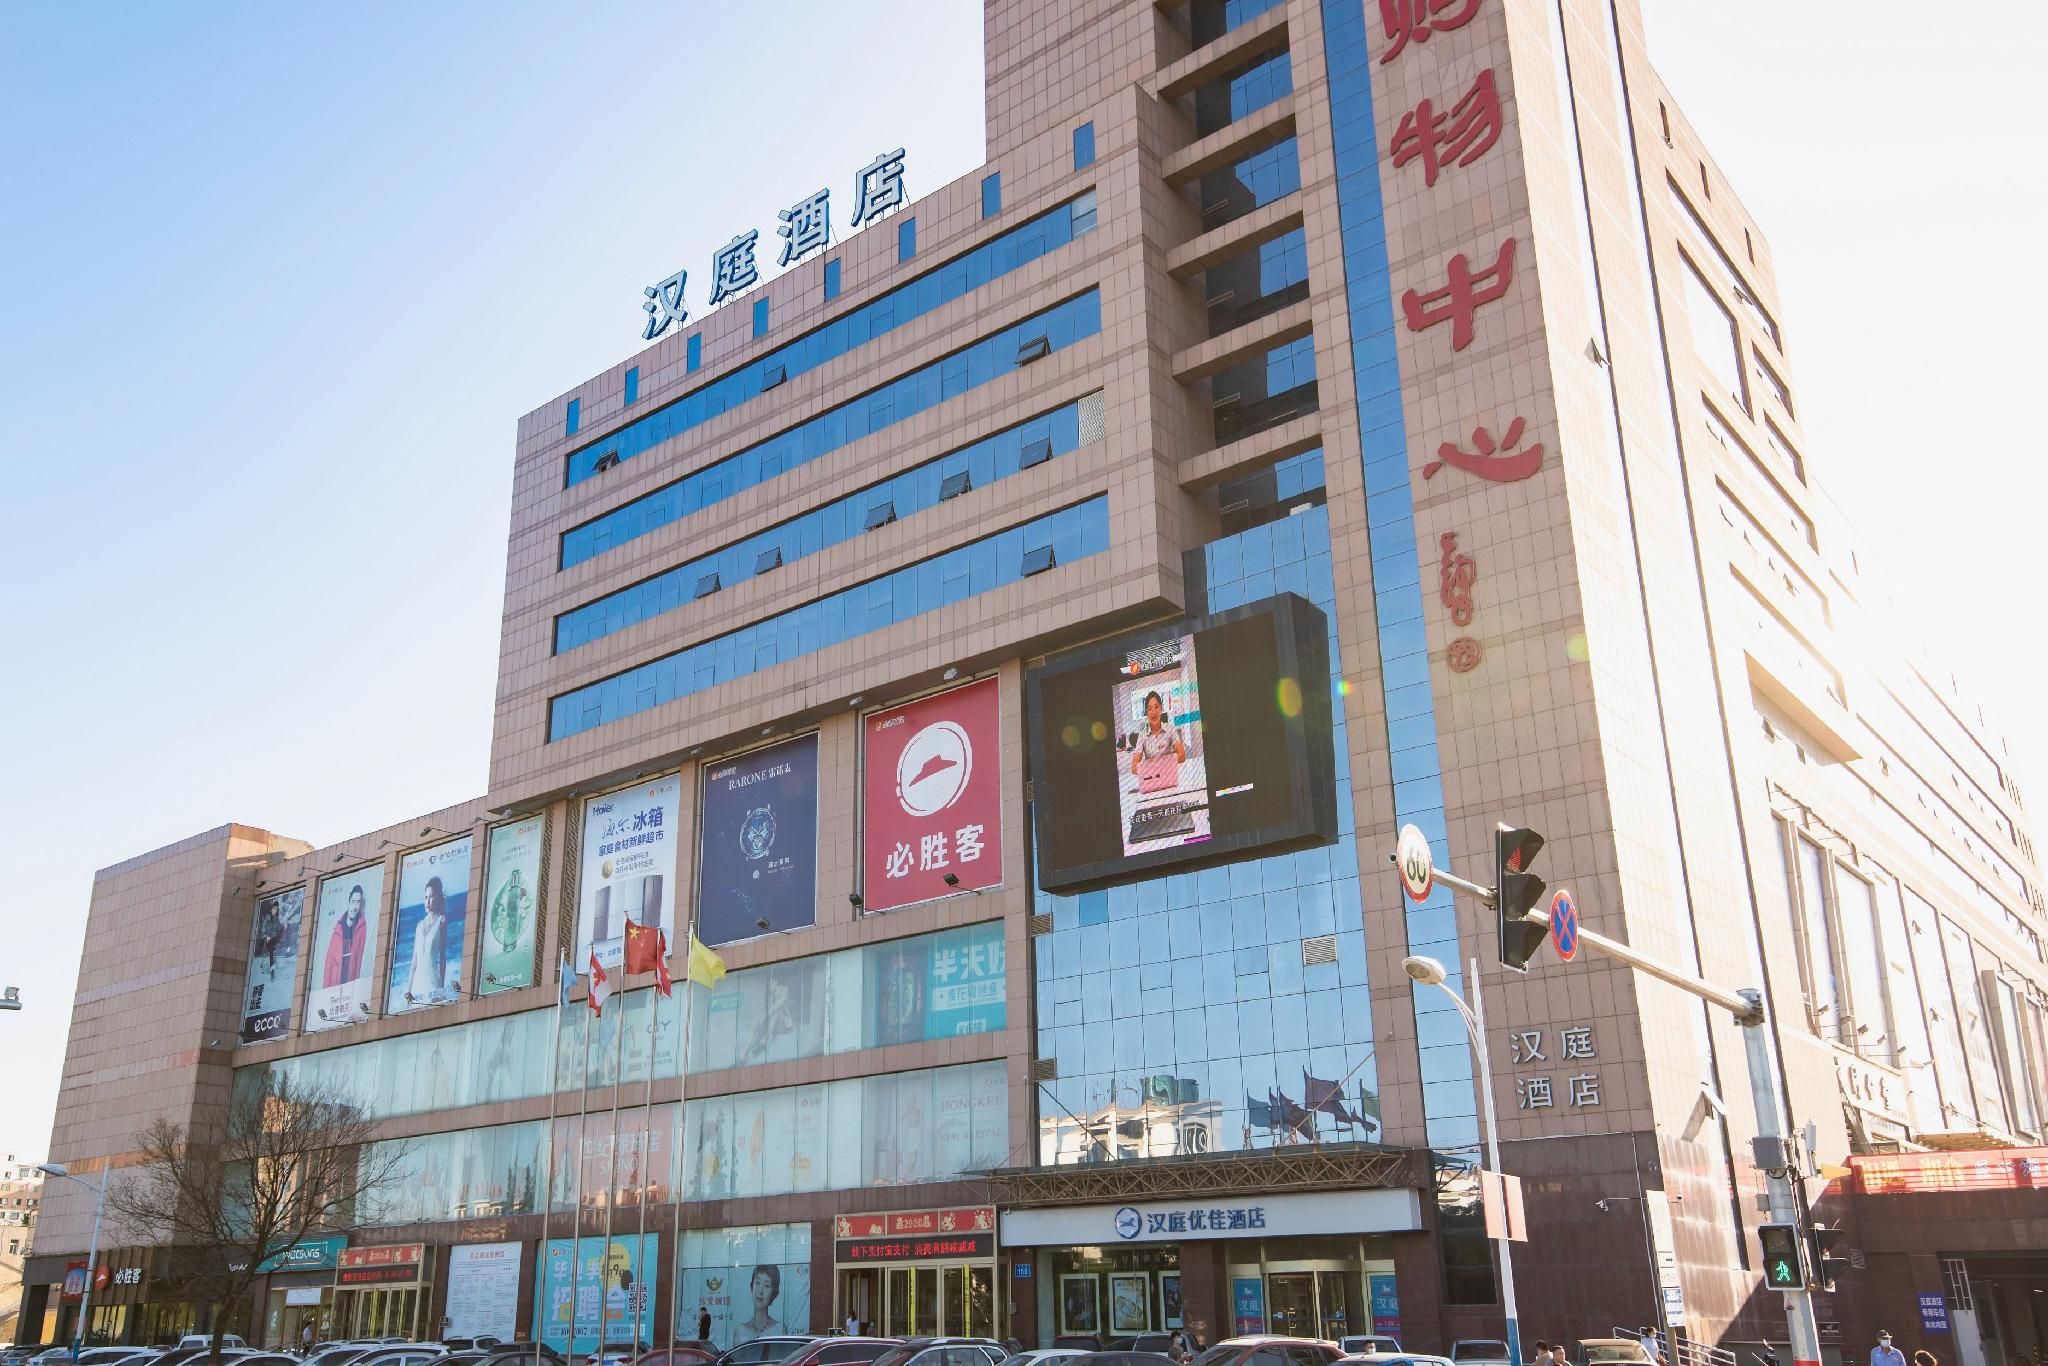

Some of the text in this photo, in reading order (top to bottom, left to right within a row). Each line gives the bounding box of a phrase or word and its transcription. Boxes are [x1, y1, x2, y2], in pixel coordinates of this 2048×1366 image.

[642, 147, 905, 340] 汉庭酒店
[729, 769, 768, 791] RARONE
[592, 803, 614, 816] Haier
[885, 824, 985, 879] 必胜客
[254, 1015, 281, 1033] ecco
[1511, 1026, 1597, 1064] 汉庭
[1517, 1073, 1600, 1110] 酒店
[1147, 1207, 1266, 1234] 汉庭优佳酒店
[115, 1268, 142, 1284] 必胜客
